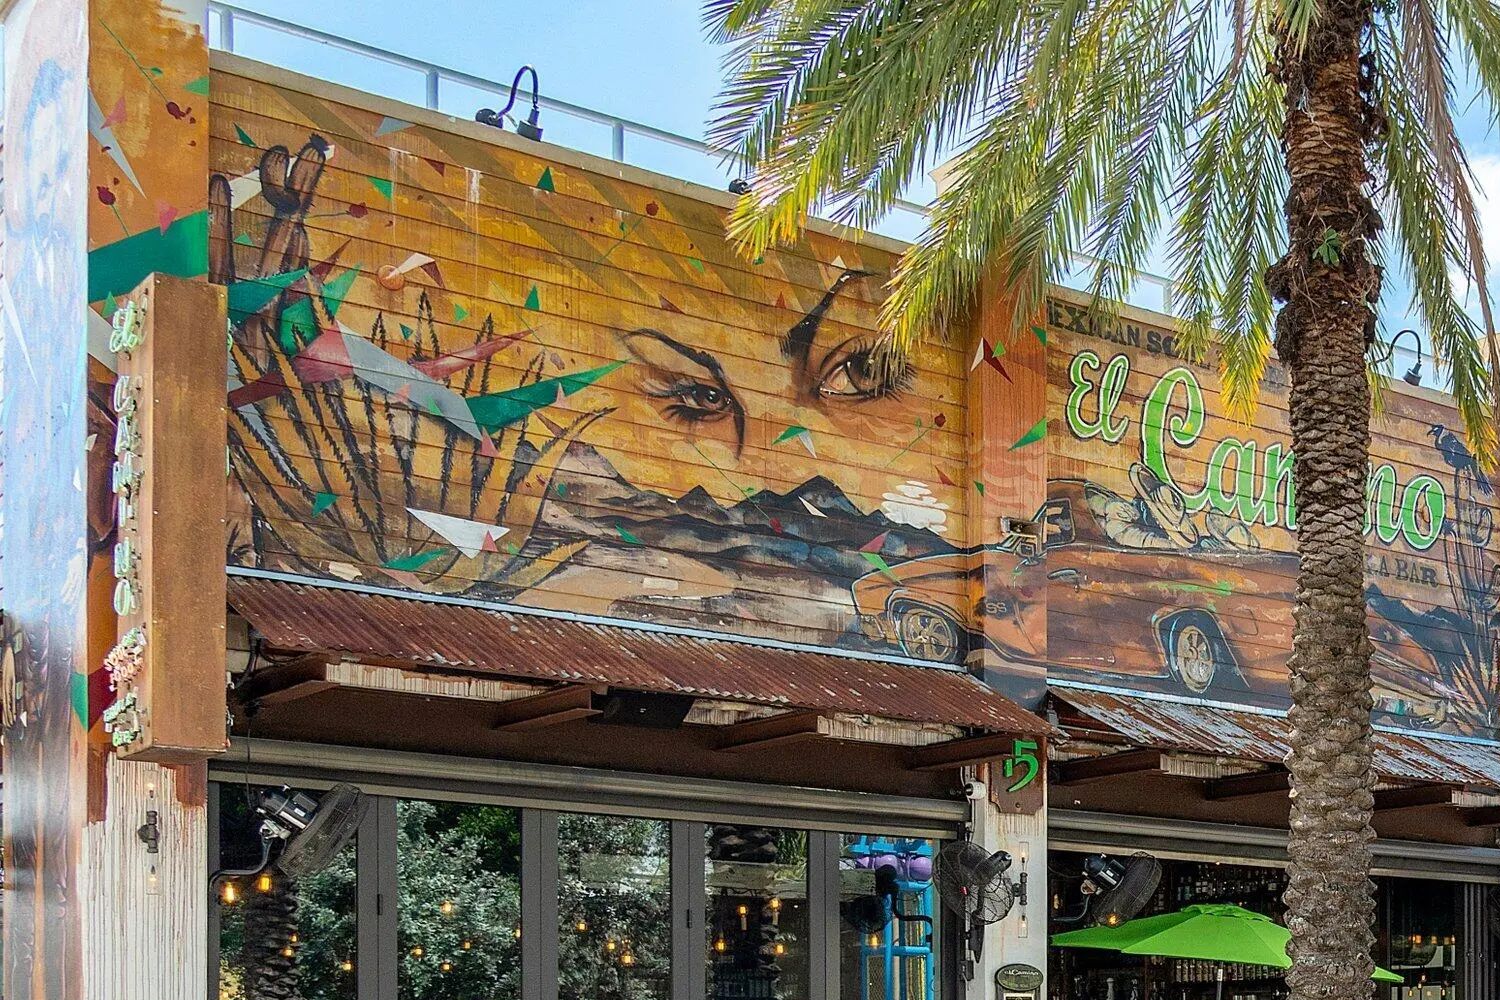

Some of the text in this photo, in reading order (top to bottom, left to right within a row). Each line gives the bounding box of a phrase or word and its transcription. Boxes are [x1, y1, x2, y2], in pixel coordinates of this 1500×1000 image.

[1066, 351, 1445, 549] El Camno
[1395, 558, 1439, 587] BAR
